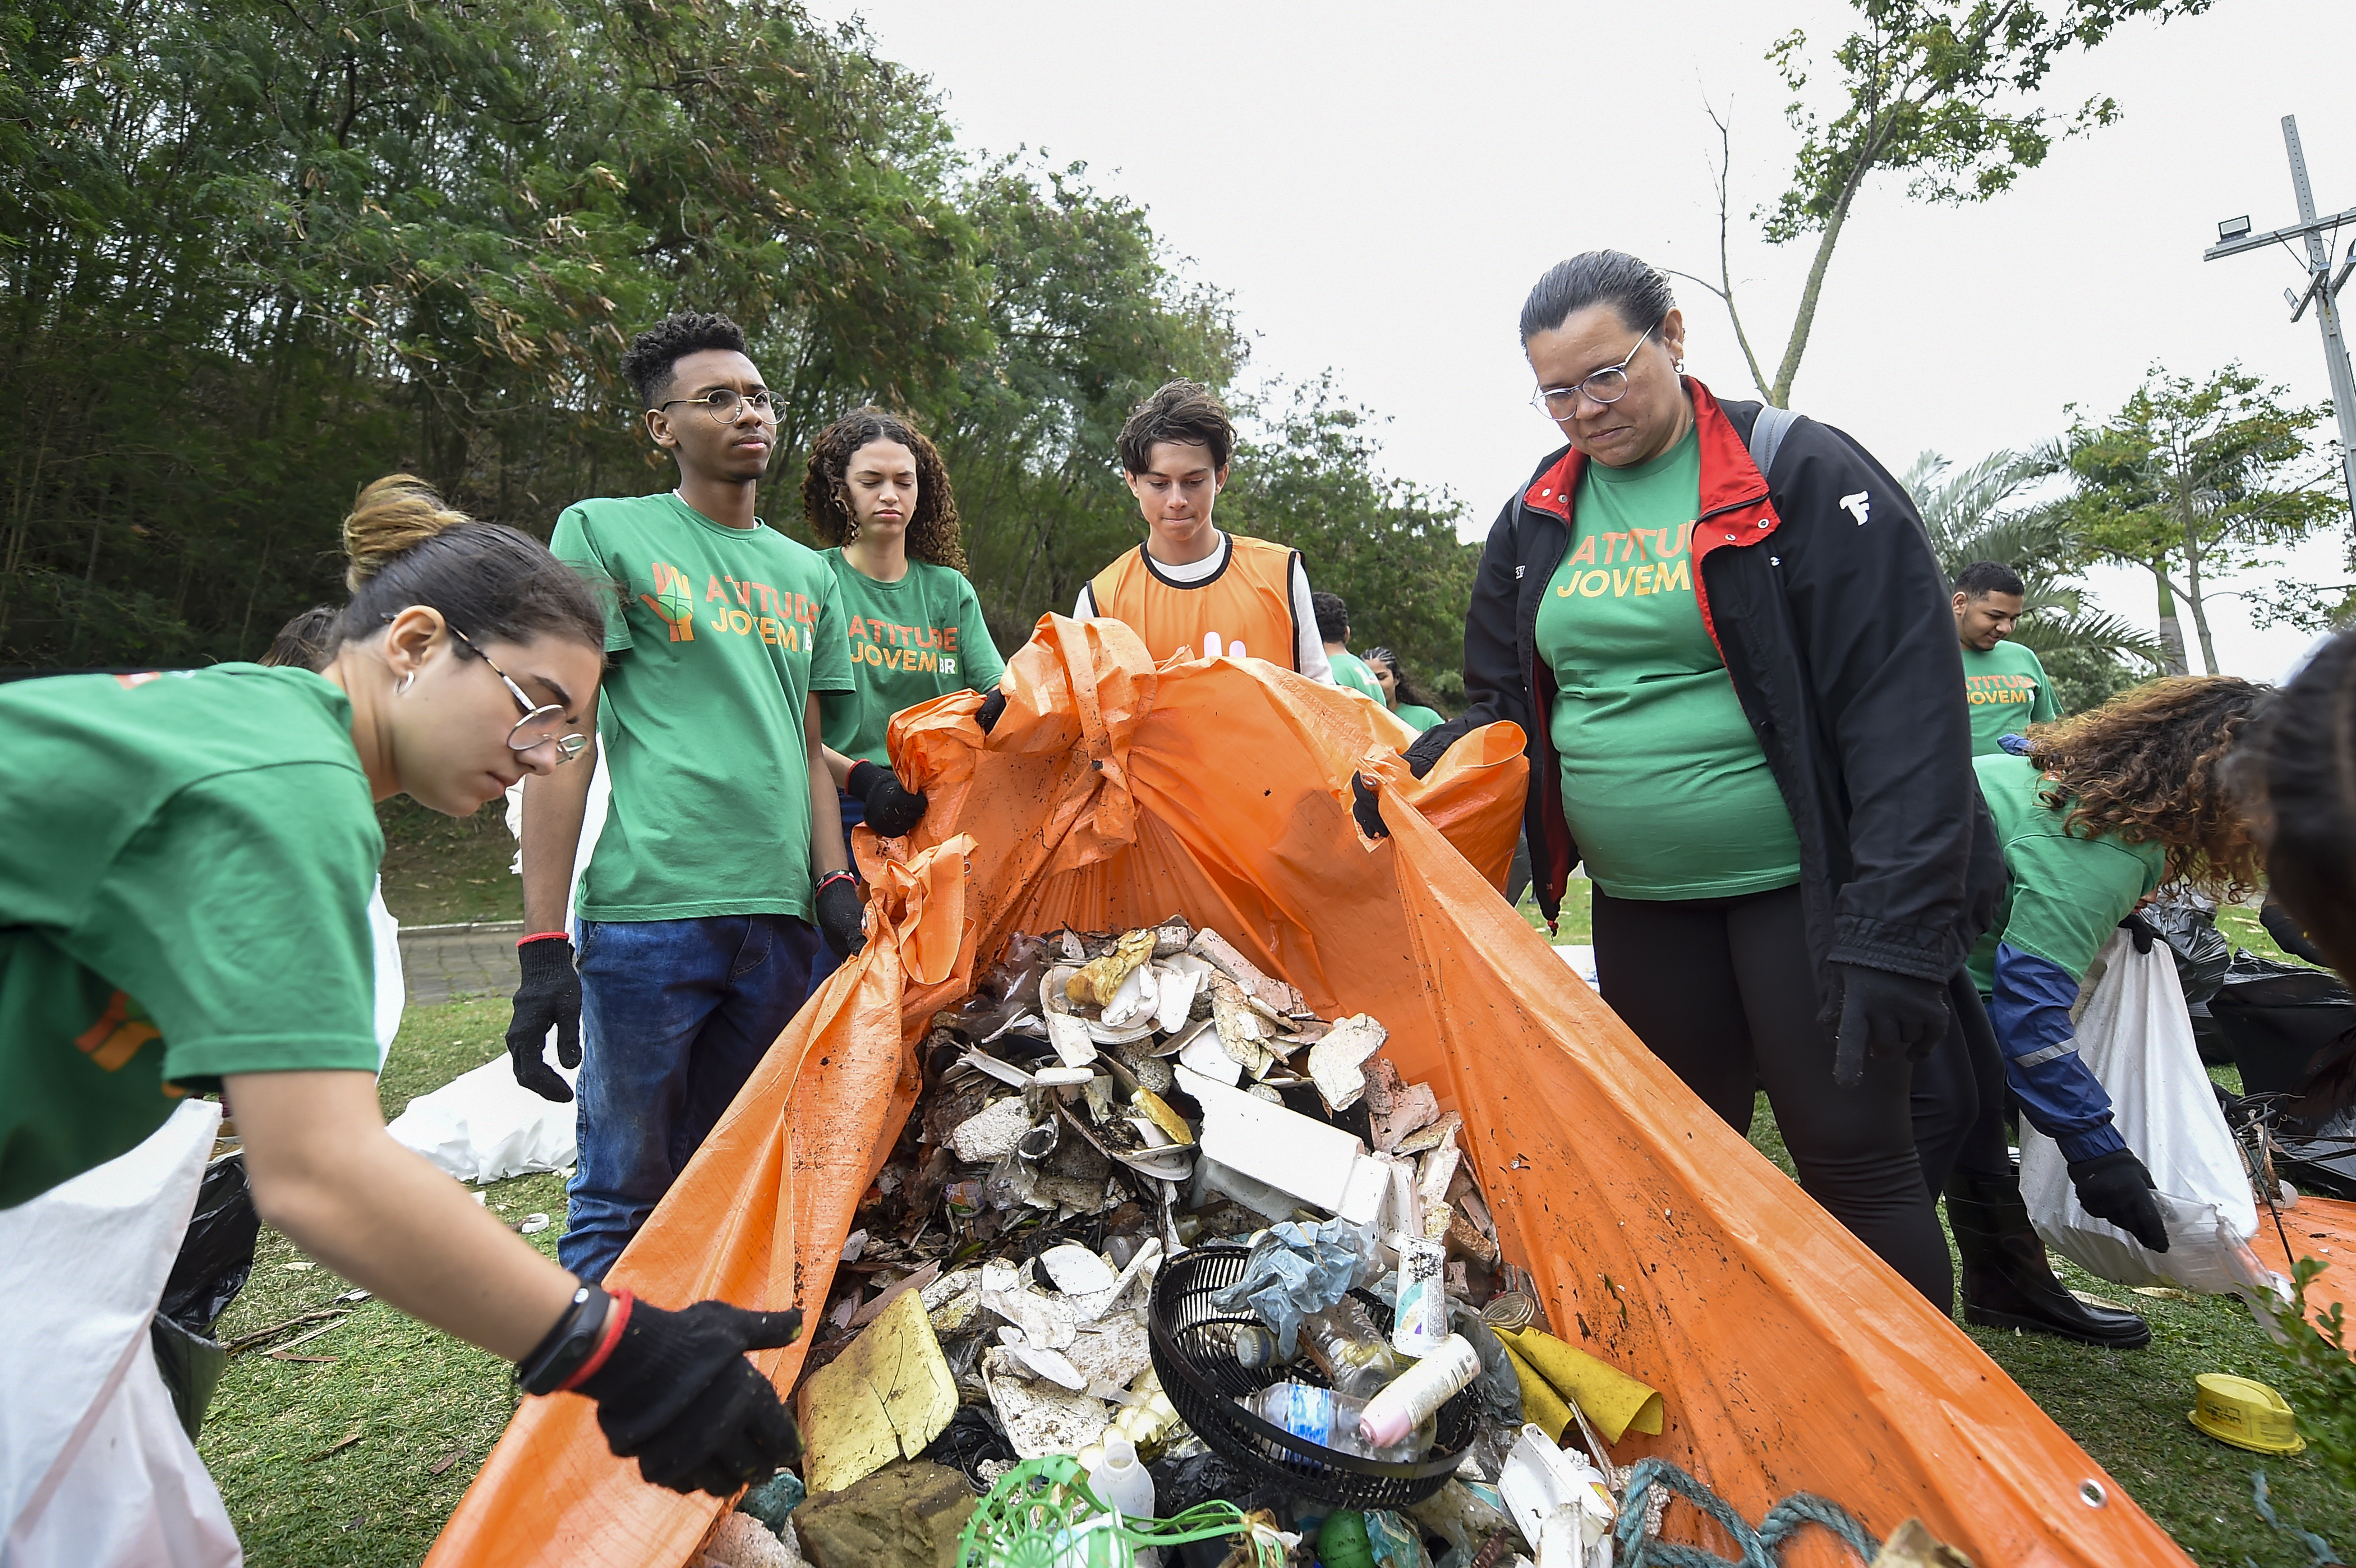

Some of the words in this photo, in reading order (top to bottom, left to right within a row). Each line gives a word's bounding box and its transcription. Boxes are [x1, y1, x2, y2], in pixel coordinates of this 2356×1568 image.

[1568, 519, 1696, 566] ATITU
[1557, 560, 1691, 597] JOVEM
[711, 607, 798, 652] JOEM
[848, 615, 958, 651] ATITUDE
[851, 641, 938, 673] JOVEM
